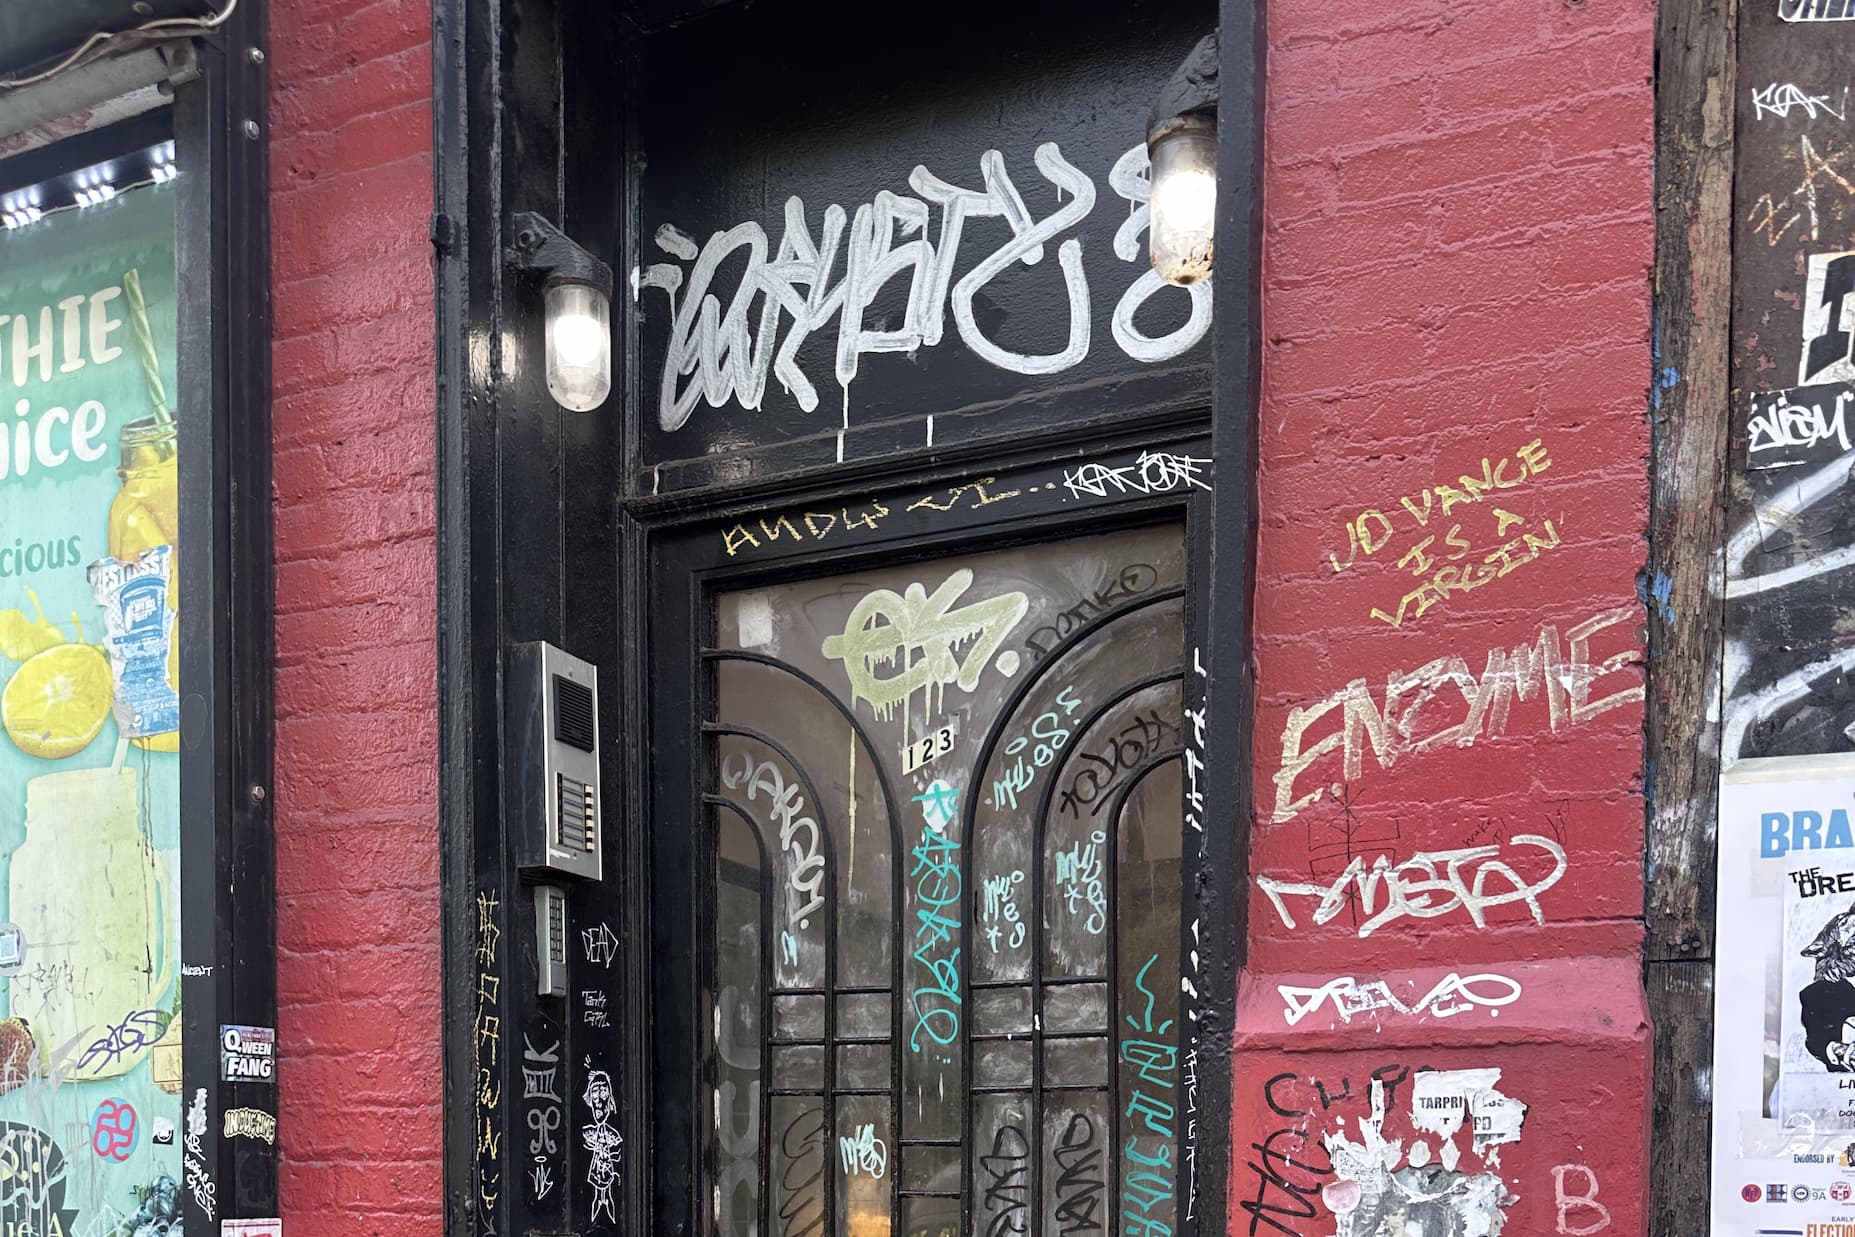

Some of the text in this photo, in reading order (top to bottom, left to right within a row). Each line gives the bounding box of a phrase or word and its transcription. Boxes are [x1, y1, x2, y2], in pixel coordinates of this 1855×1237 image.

[0, 286, 123, 387] HIE
[1328, 438, 1553, 573] JD VANCE
[1398, 507, 1525, 577] IS A
[1370, 519, 1561, 629] VIRGIN
[909, 728, 951, 770] 123
[1760, 809, 1855, 858] BRA
[1787, 866, 1821, 884] THE
[223, 1029, 273, 1056] QWEEN
[227, 1057, 272, 1078] FANG
